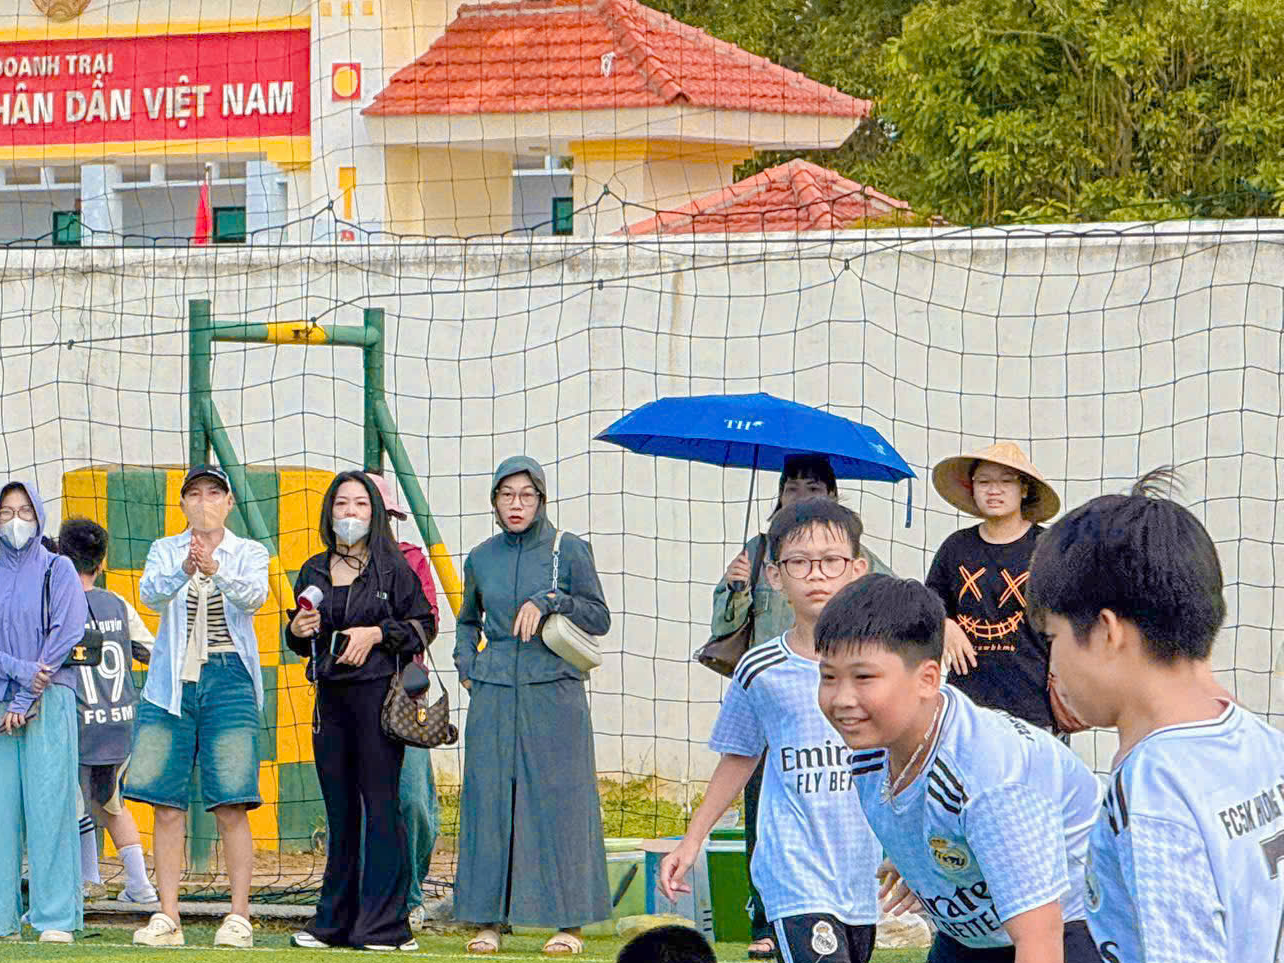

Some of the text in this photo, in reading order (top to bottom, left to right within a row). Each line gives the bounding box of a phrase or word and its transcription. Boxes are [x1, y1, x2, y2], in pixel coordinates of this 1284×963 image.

[66, 53, 113, 79] TRẠI
[143, 74, 211, 128] VIỆT
[222, 80, 294, 117] NAM
[84, 705, 133, 725] FC 5M
[797, 772, 822, 794] FLY
